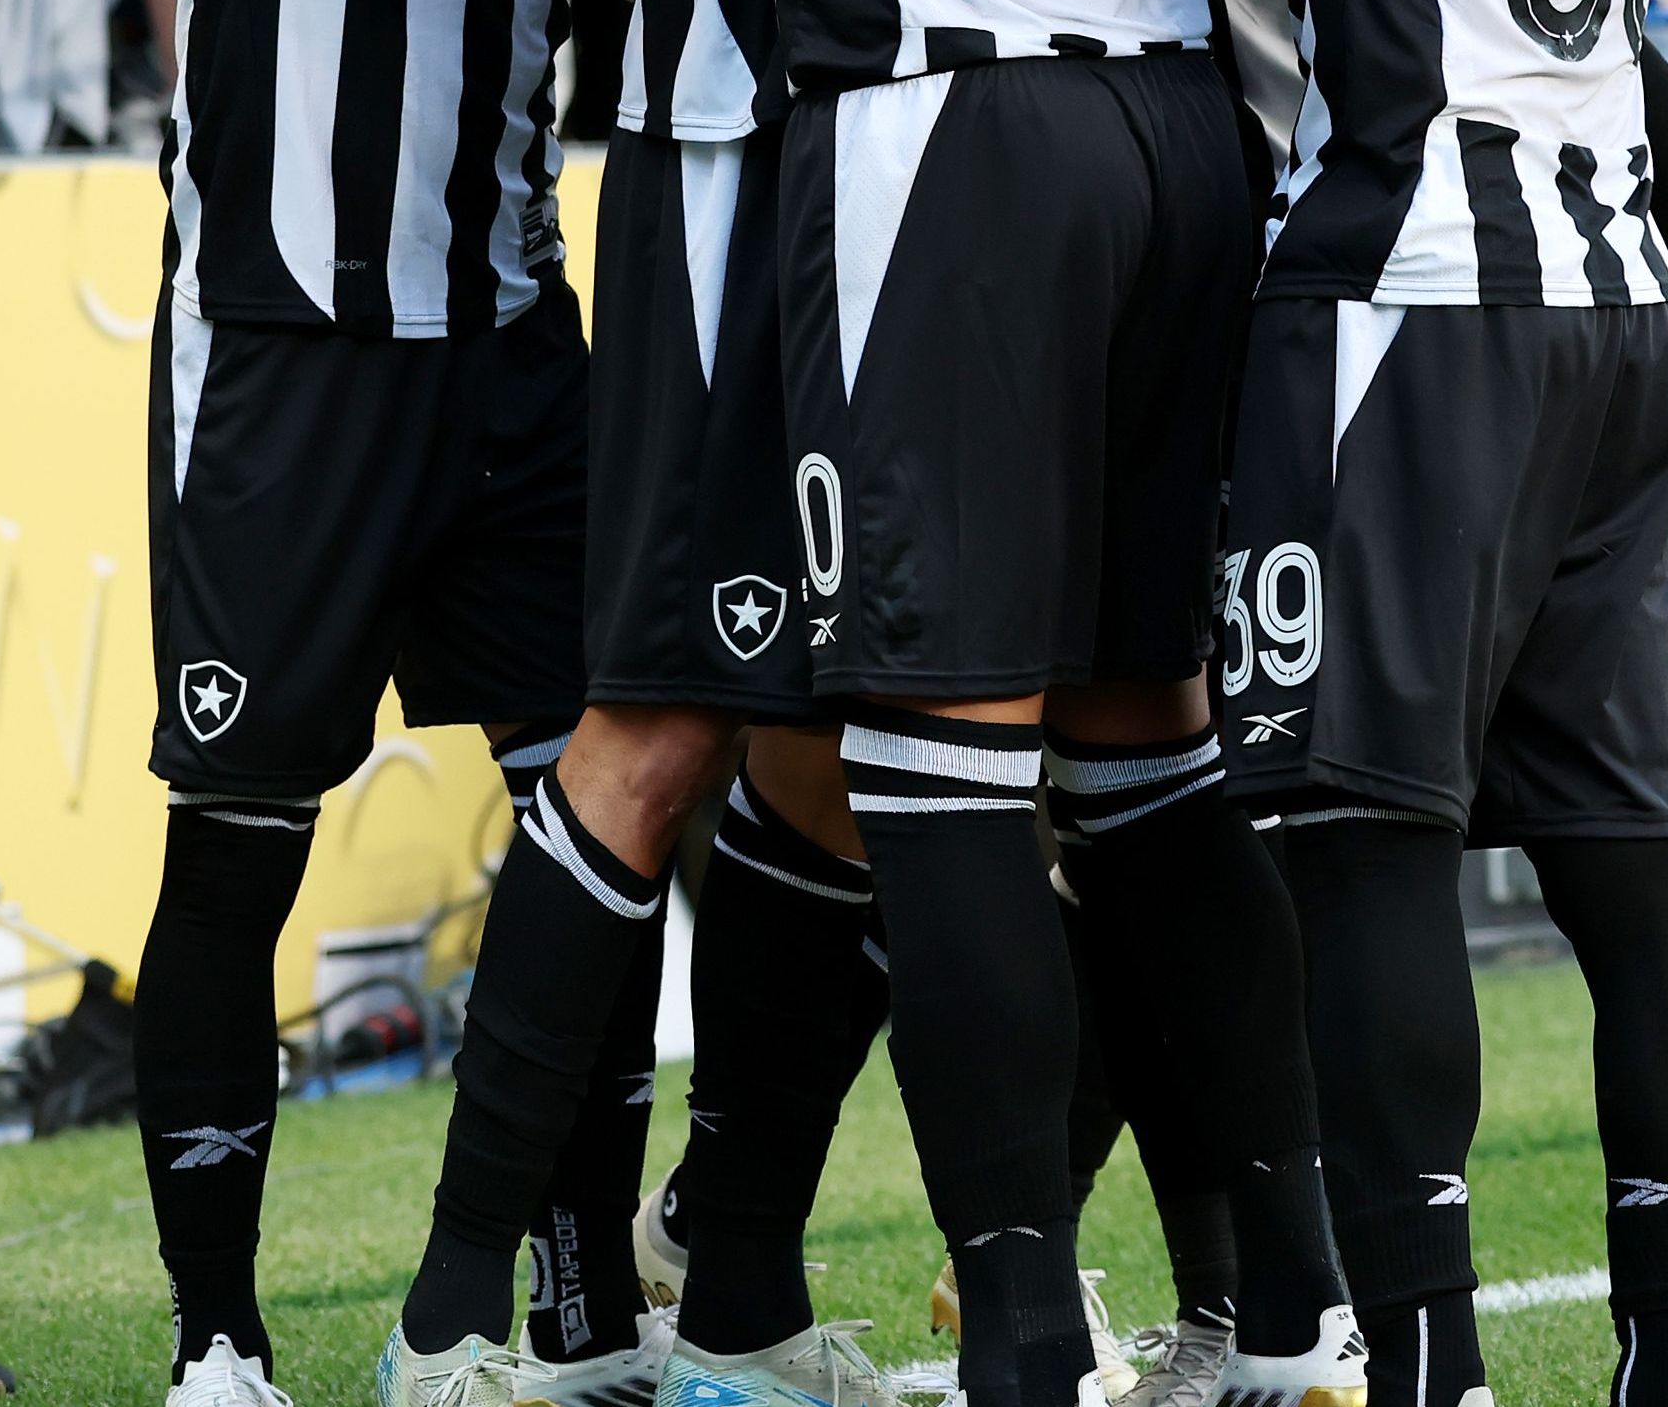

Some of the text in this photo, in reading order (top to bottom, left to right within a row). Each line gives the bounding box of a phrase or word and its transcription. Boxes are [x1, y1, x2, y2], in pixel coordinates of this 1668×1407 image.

[324, 259, 368, 270] RBK-DRY
[795, 452, 844, 602] 0
[1222, 541, 1324, 697] 39
